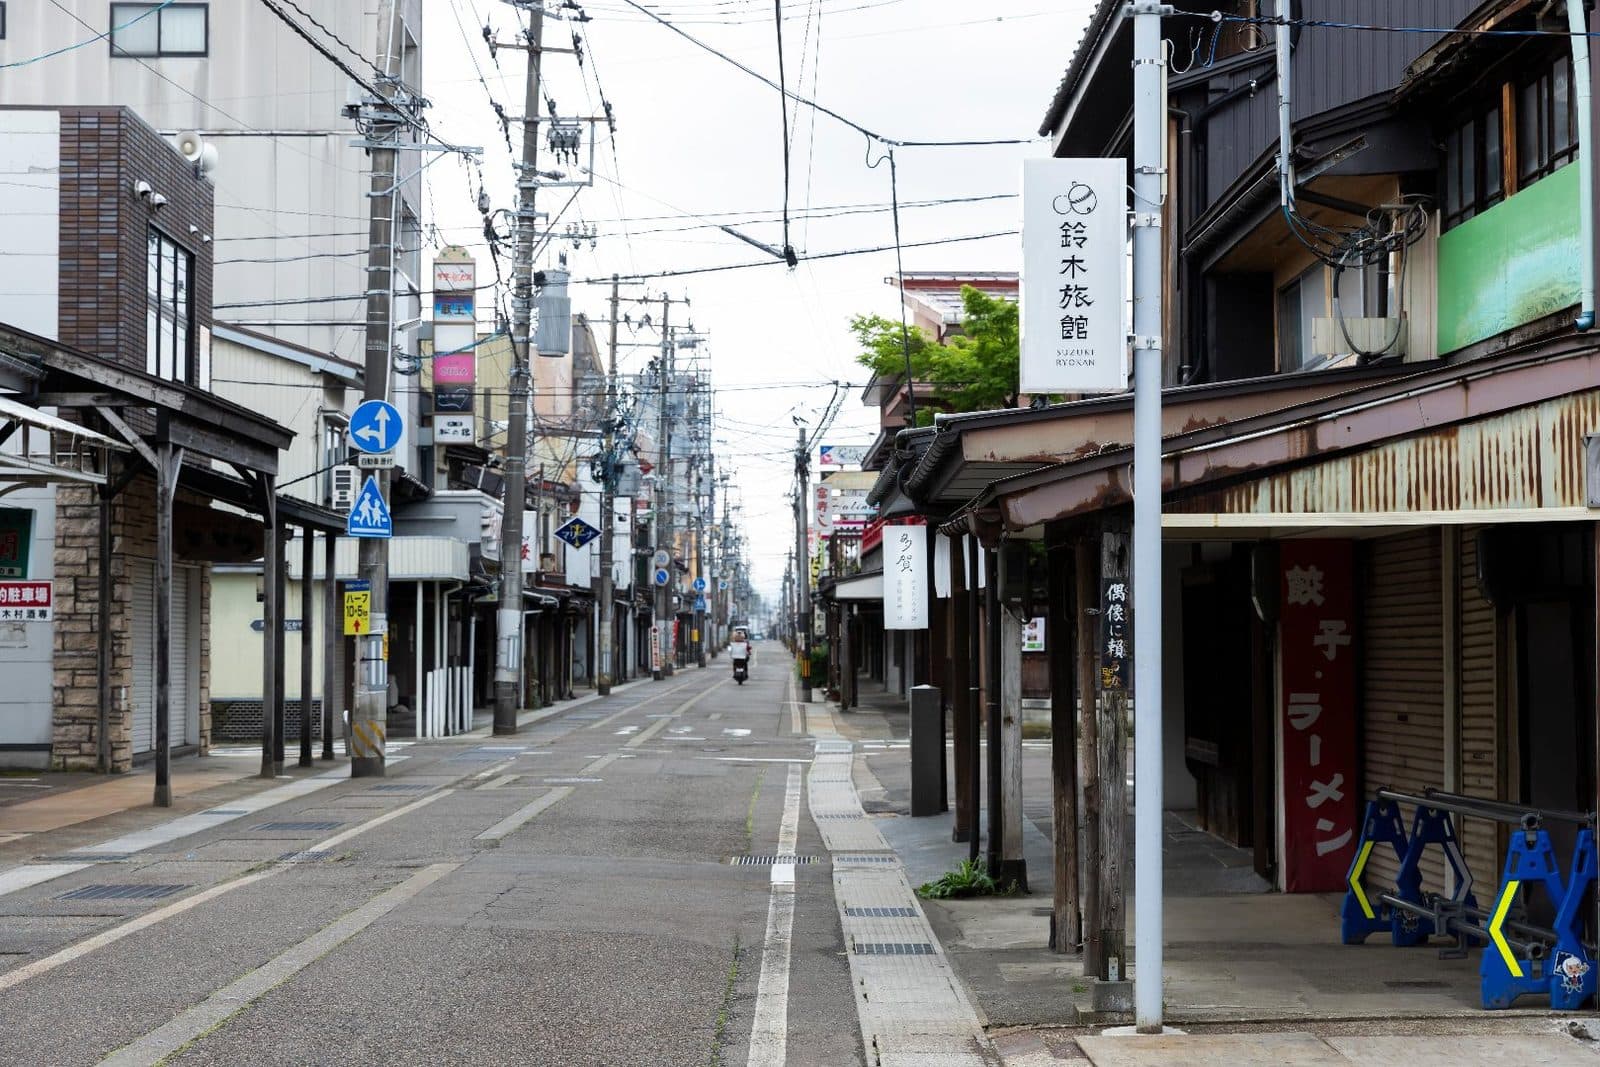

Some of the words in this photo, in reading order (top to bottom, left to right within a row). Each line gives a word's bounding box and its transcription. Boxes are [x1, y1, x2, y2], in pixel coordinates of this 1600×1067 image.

[1059, 221, 1094, 340] 鈴木旅館
[1056, 358, 1095, 367] RYOKAN
[896, 533, 913, 573] 多賀
[346, 593, 368, 603] ハーフ
[1285, 565, 1353, 857] 餃子・ラーメン
